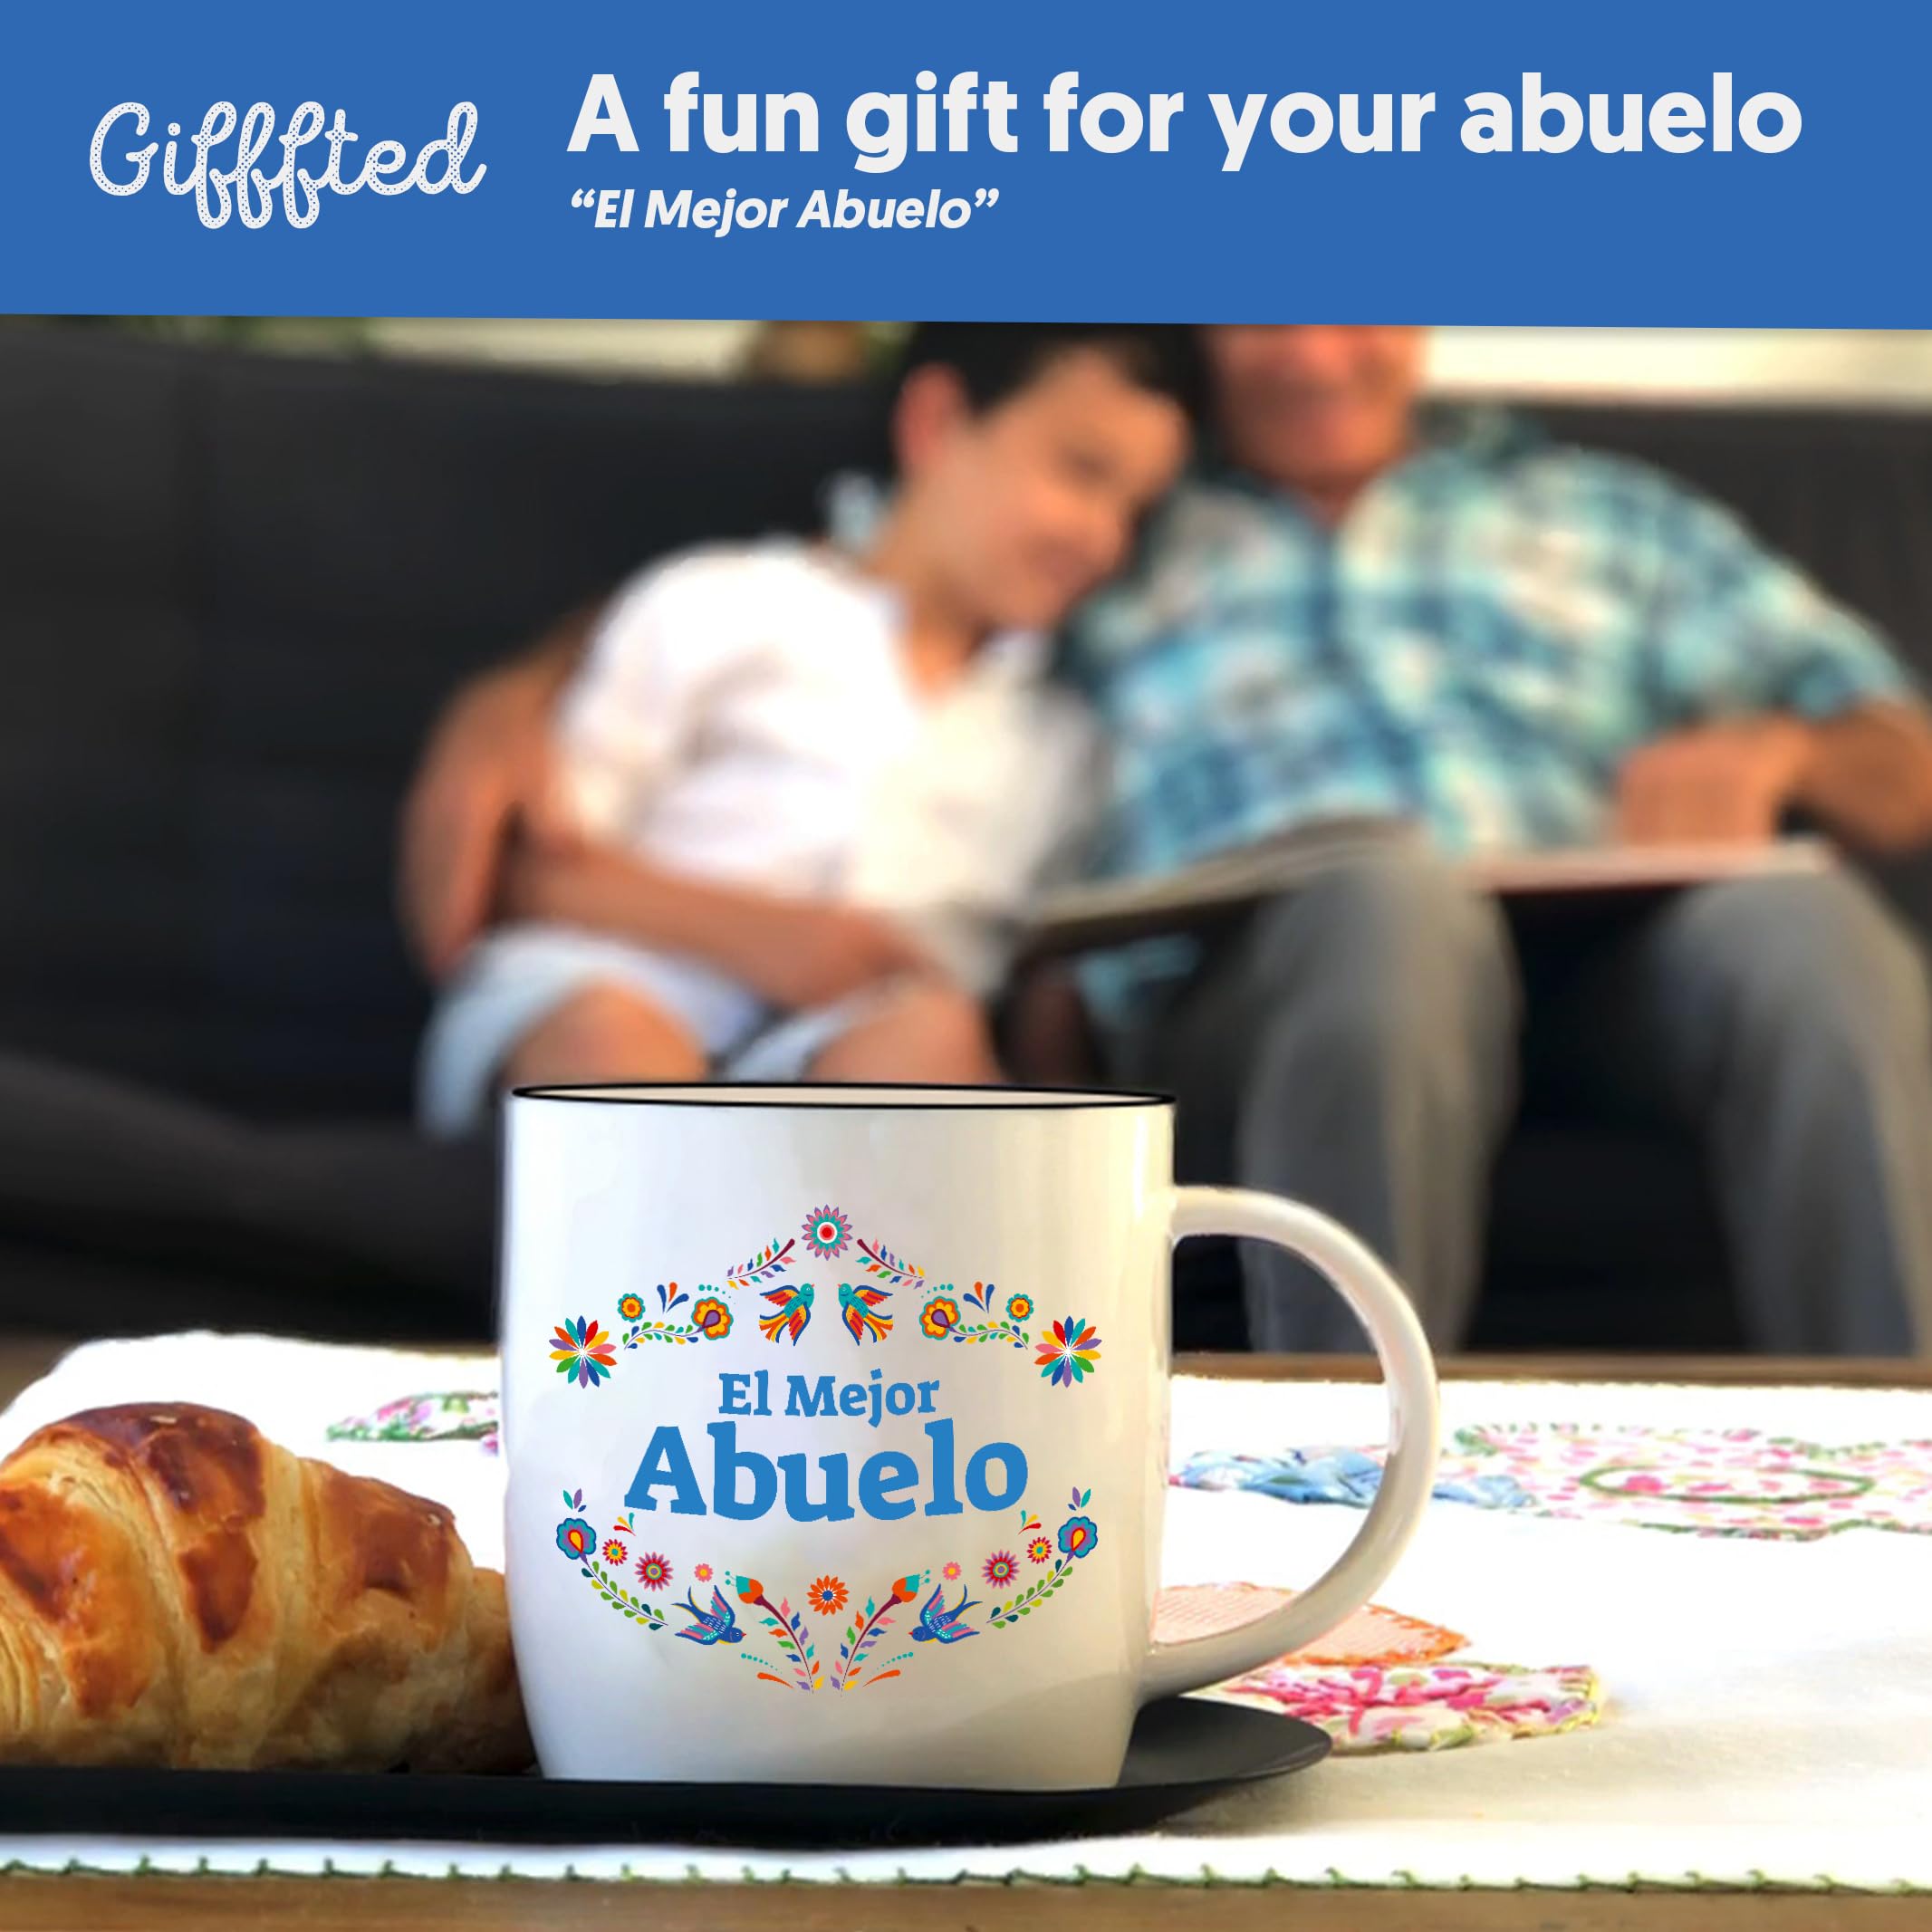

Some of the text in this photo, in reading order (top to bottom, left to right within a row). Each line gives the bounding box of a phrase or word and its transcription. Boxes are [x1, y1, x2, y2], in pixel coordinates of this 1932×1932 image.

[717, 1368, 940, 1428] El Mejor
[624, 1418, 1028, 1523] Abuelo
